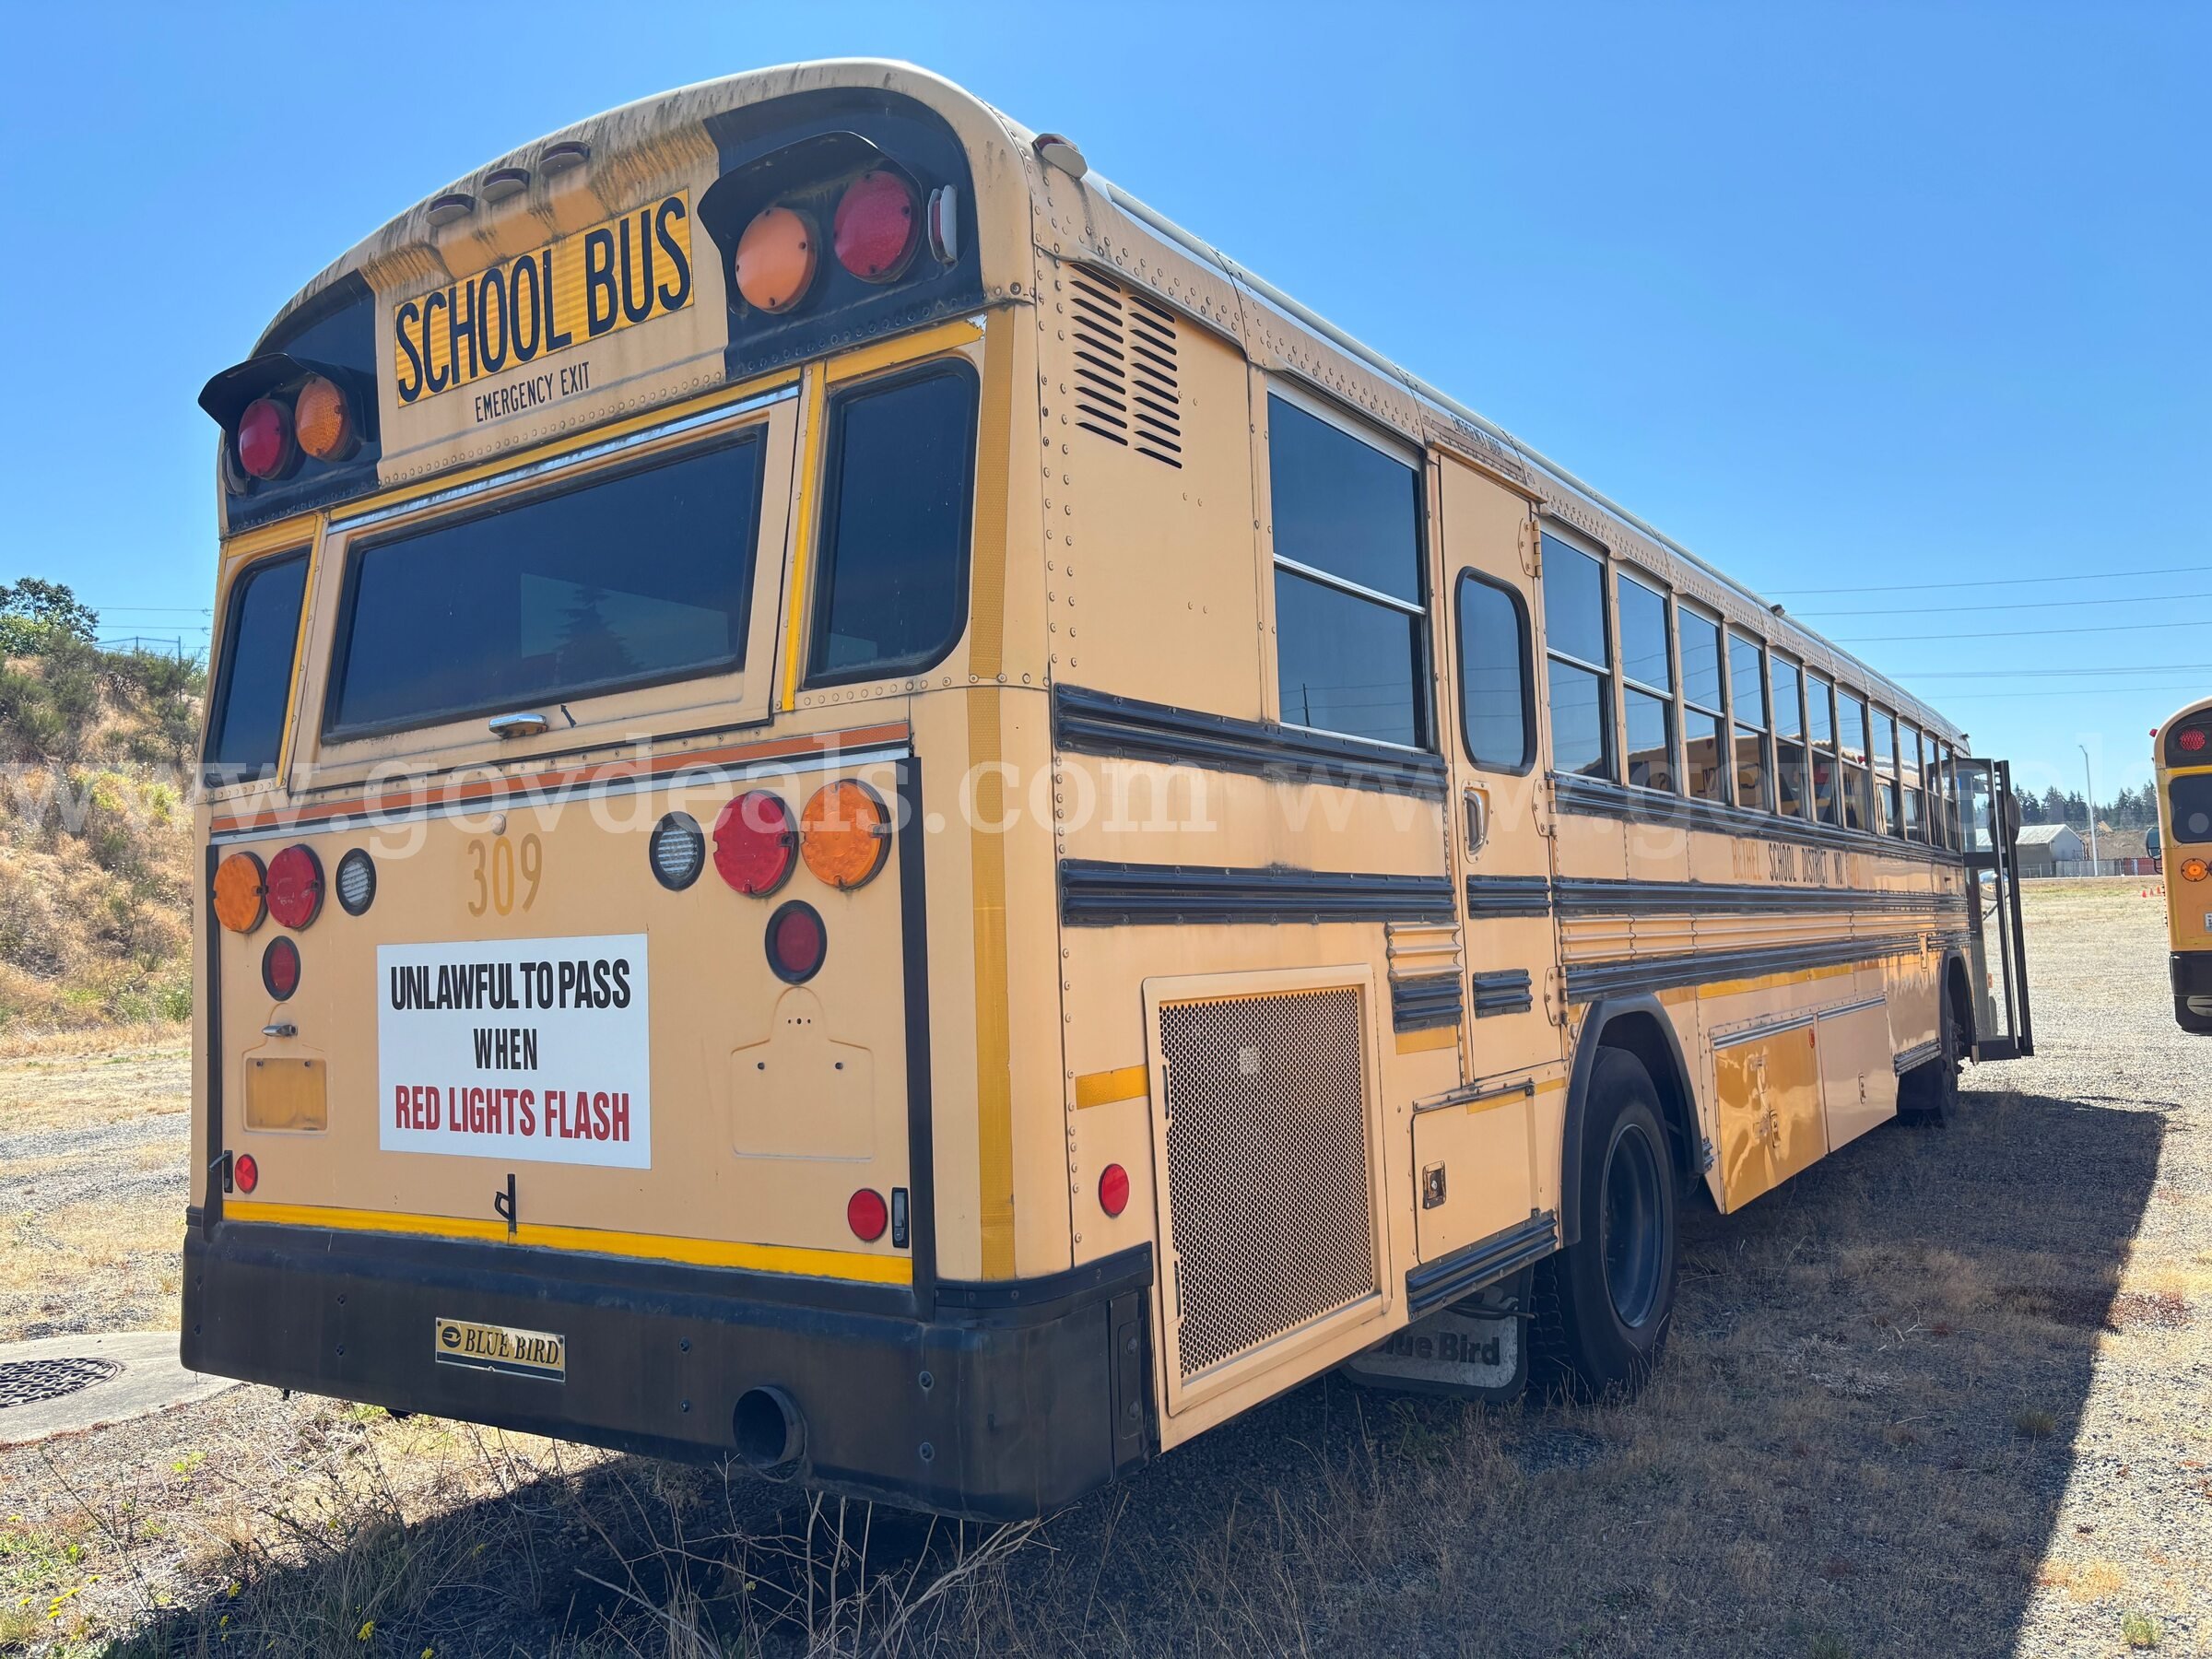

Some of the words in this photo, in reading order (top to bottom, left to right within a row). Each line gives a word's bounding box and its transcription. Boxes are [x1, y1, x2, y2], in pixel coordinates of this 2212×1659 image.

[395, 250, 572, 403] SCHOOL
[585, 196, 691, 337] BUS
[476, 373, 553, 423] EMERGENCY
[560, 361, 591, 396] EXIT
[467, 832, 542, 917] 309
[1769, 842, 1797, 882] SCHOOL
[1801, 847, 1829, 884] DISTRICT
[391, 963, 519, 1010] UNLAWFUL
[520, 961, 553, 1009] TO
[558, 959, 630, 1008] PASS
[473, 1028, 537, 1070] WHEN
[395, 1085, 441, 1131] RED
[449, 1087, 535, 1136] LIGHTS
[544, 1090, 629, 1142] FLASH
[465, 1328, 510, 1358] BLUE
[1374, 1334, 1432, 1357] lue
[1438, 1332, 1500, 1366] Bird
